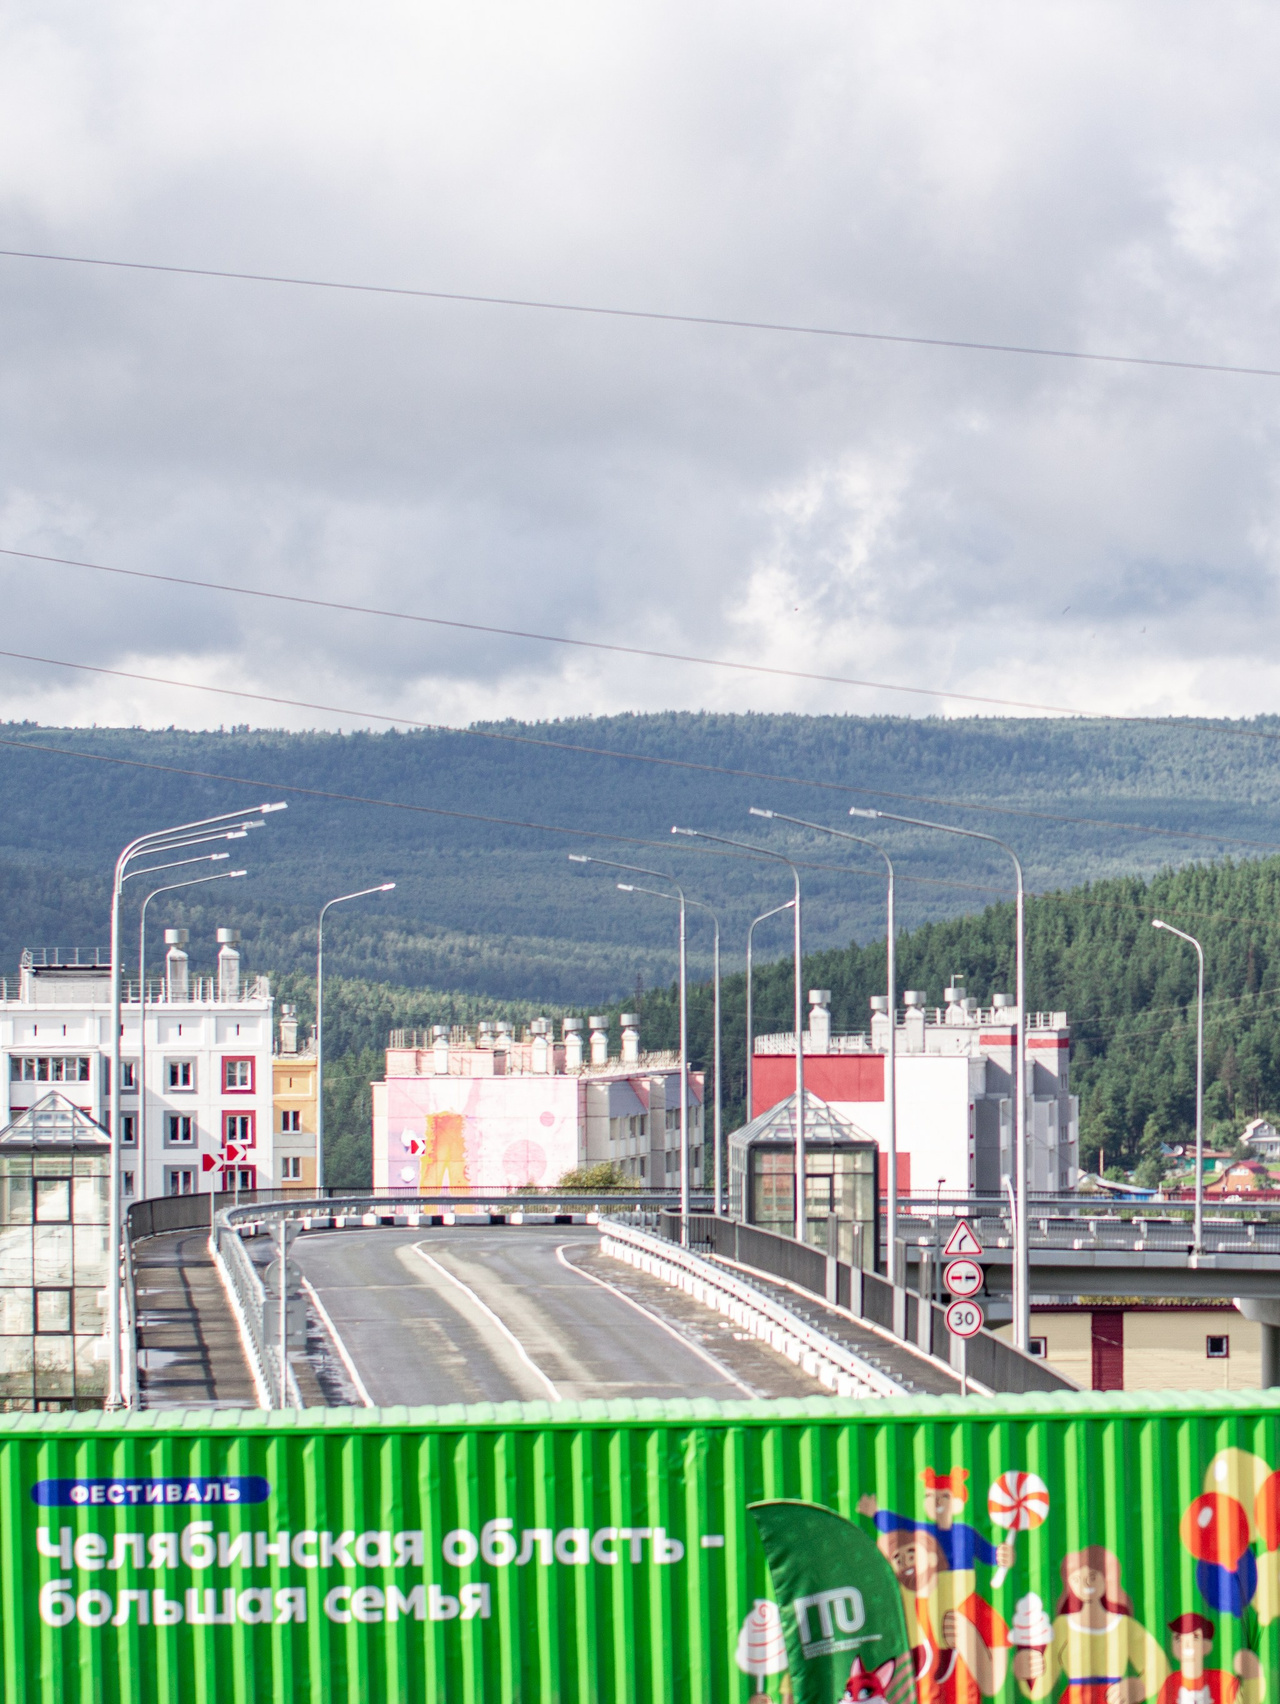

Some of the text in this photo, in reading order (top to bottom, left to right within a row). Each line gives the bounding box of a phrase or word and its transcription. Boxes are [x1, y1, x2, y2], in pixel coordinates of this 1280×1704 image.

[954, 1311, 975, 1326] 30
[69, 1482, 241, 1504] ФЕСТИВАЛЬ
[36, 1520, 424, 1570] Челябинская
[442, 1517, 685, 1567] область
[39, 1579, 491, 1628] большая семья
